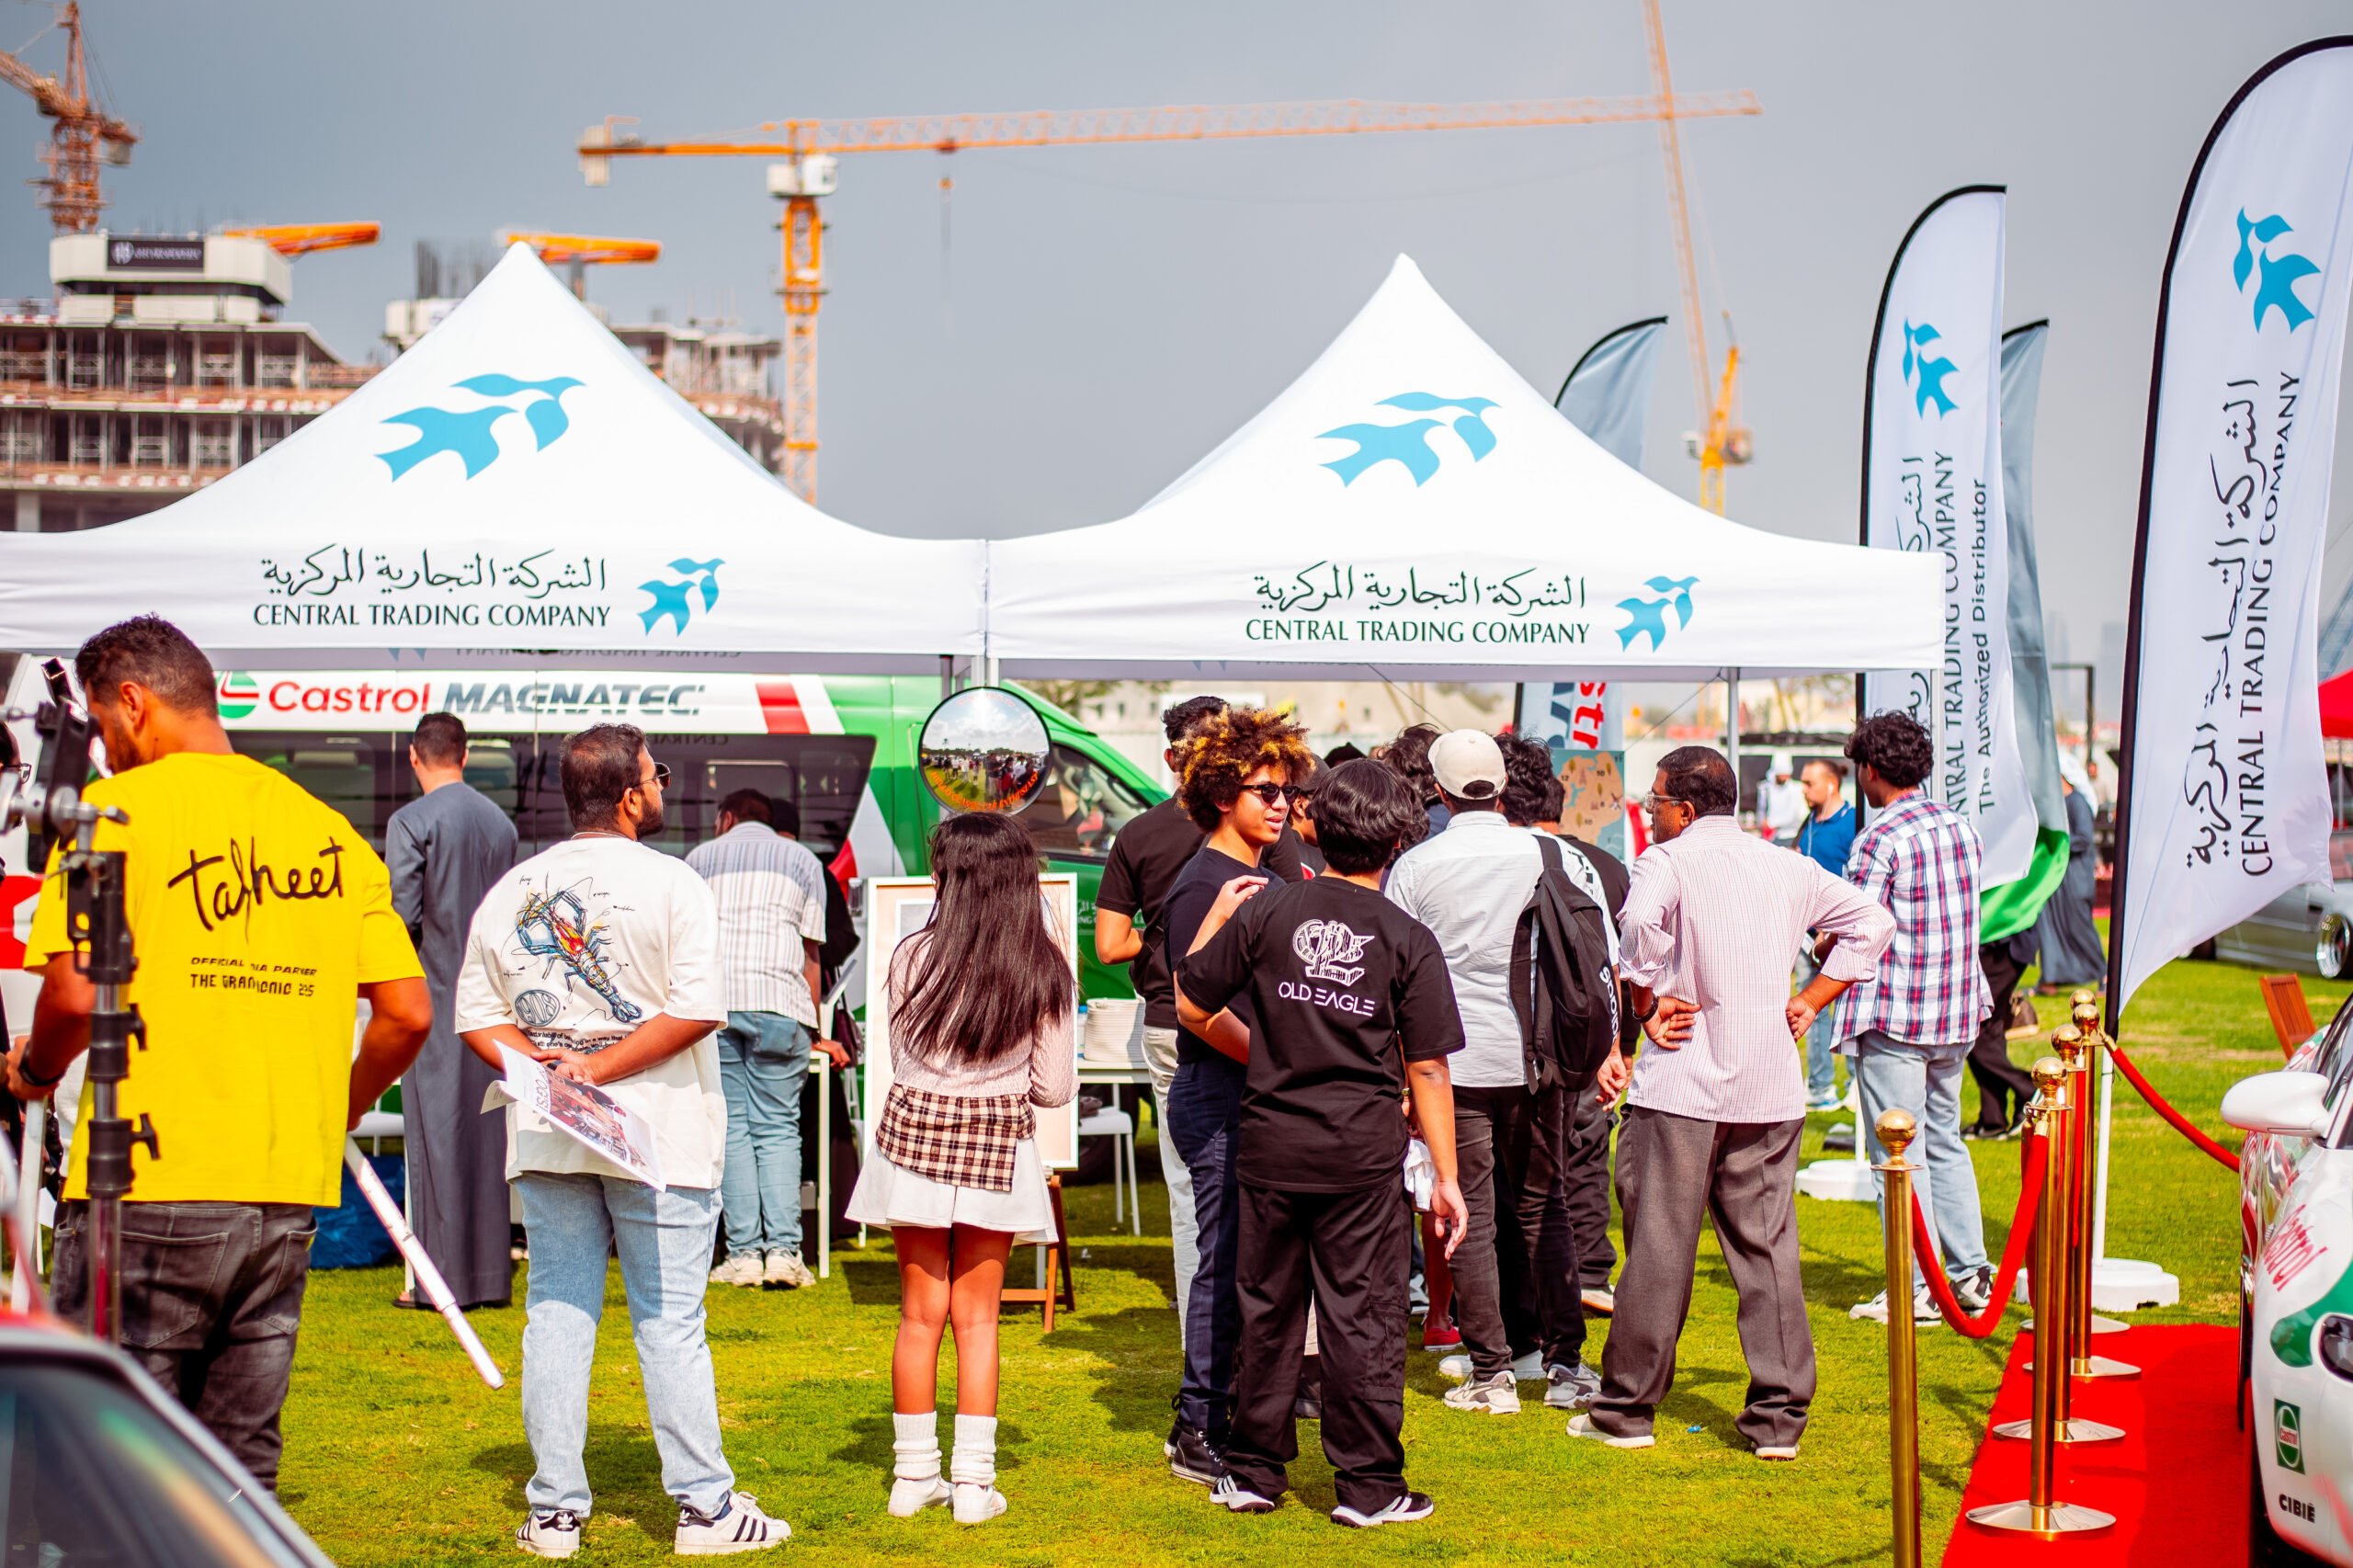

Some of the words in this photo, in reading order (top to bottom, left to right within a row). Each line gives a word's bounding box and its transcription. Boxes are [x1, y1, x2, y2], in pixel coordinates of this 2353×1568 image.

[2258, 370, 2301, 546] COMPANY
[1934, 449, 1960, 594] COMPANY
[260, 542, 365, 597] المركزية
[374, 547, 496, 595] التجارية
[502, 548, 606, 599] الشركة
[1971, 478, 1987, 622] Distributor
[1253, 560, 1353, 612] المركزية
[1363, 565, 1482, 612] التجارية
[1485, 566, 1586, 617] الشركة
[253, 604, 360, 627] CENTRAL
[368, 604, 481, 627] TRADING
[487, 605, 611, 628] COMPANY
[1245, 619, 1349, 642] CENTRAL
[1356, 619, 1465, 642] TRADING
[1472, 620, 1591, 644] COMPANY
[2239, 557, 2274, 719] TRADING
[1943, 603, 1963, 732] TRADING
[268, 681, 432, 713] Castrol
[443, 682, 707, 717] MAGNATEC
[1972, 632, 1992, 757] Authorized
[1945, 739, 1970, 816] NTRAL
[1978, 766, 1995, 815] The
[2237, 730, 2274, 878] CENTRAL
[190, 973, 217, 988] THE
[1279, 982, 1313, 1002] OLD
[1313, 987, 1376, 1017] EAGLE
